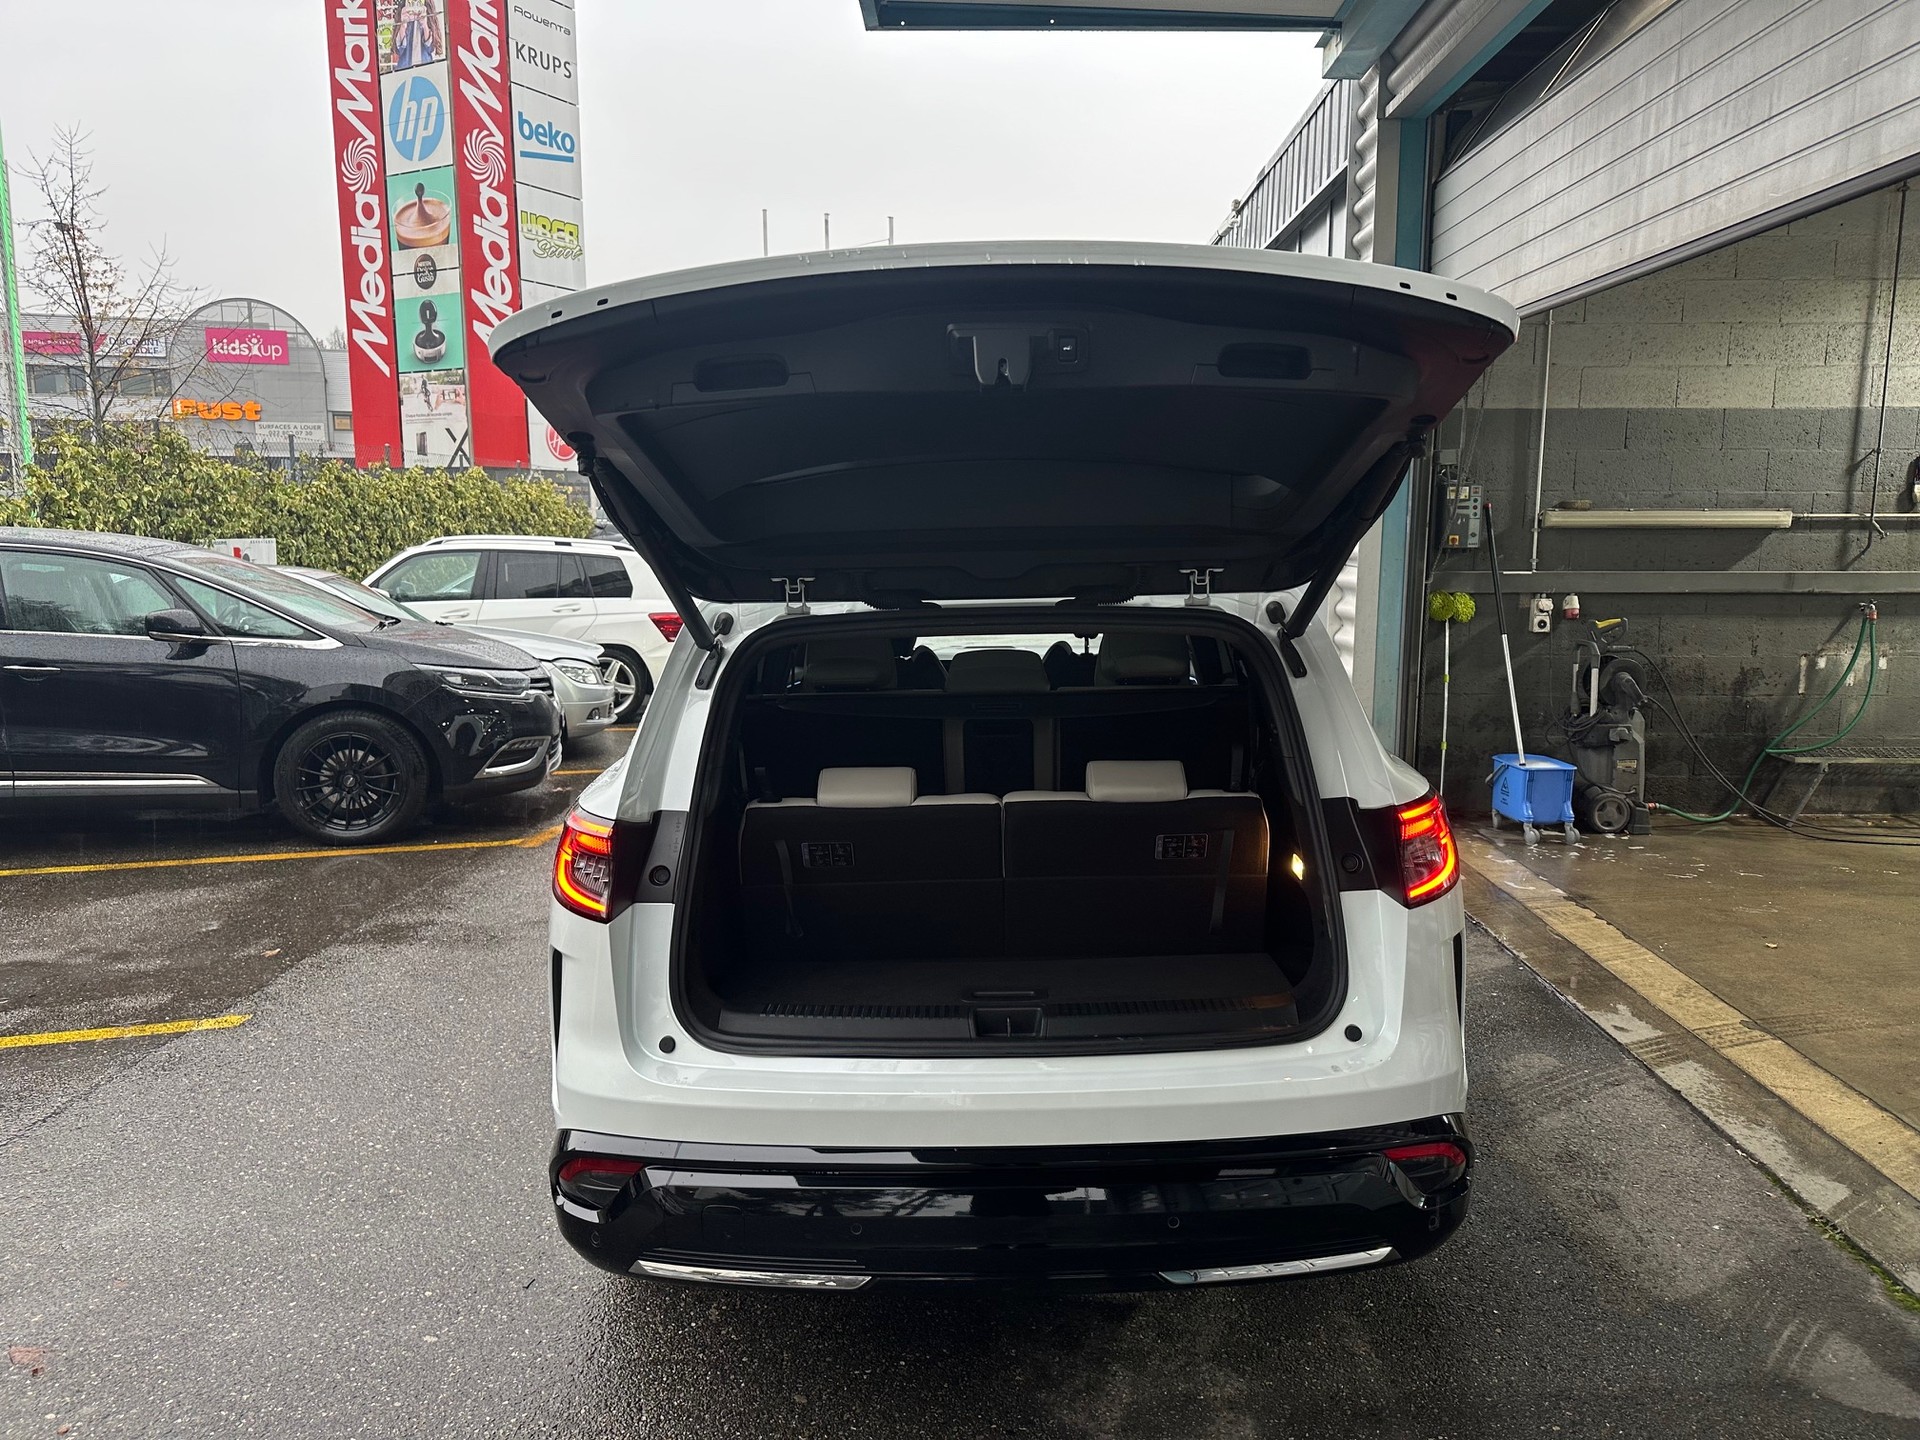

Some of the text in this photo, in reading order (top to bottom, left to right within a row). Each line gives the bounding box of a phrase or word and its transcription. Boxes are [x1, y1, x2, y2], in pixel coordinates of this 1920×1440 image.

[458, 0, 506, 149] Mar
[515, 41, 572, 79] KRUPS
[394, 76, 439, 162] hp
[517, 110, 576, 154] beko
[533, 239, 583, 260] Scoot
[350, 190, 391, 378] Media
[109, 337, 160, 346] DSCOUNT
[212, 337, 283, 360] kids up
